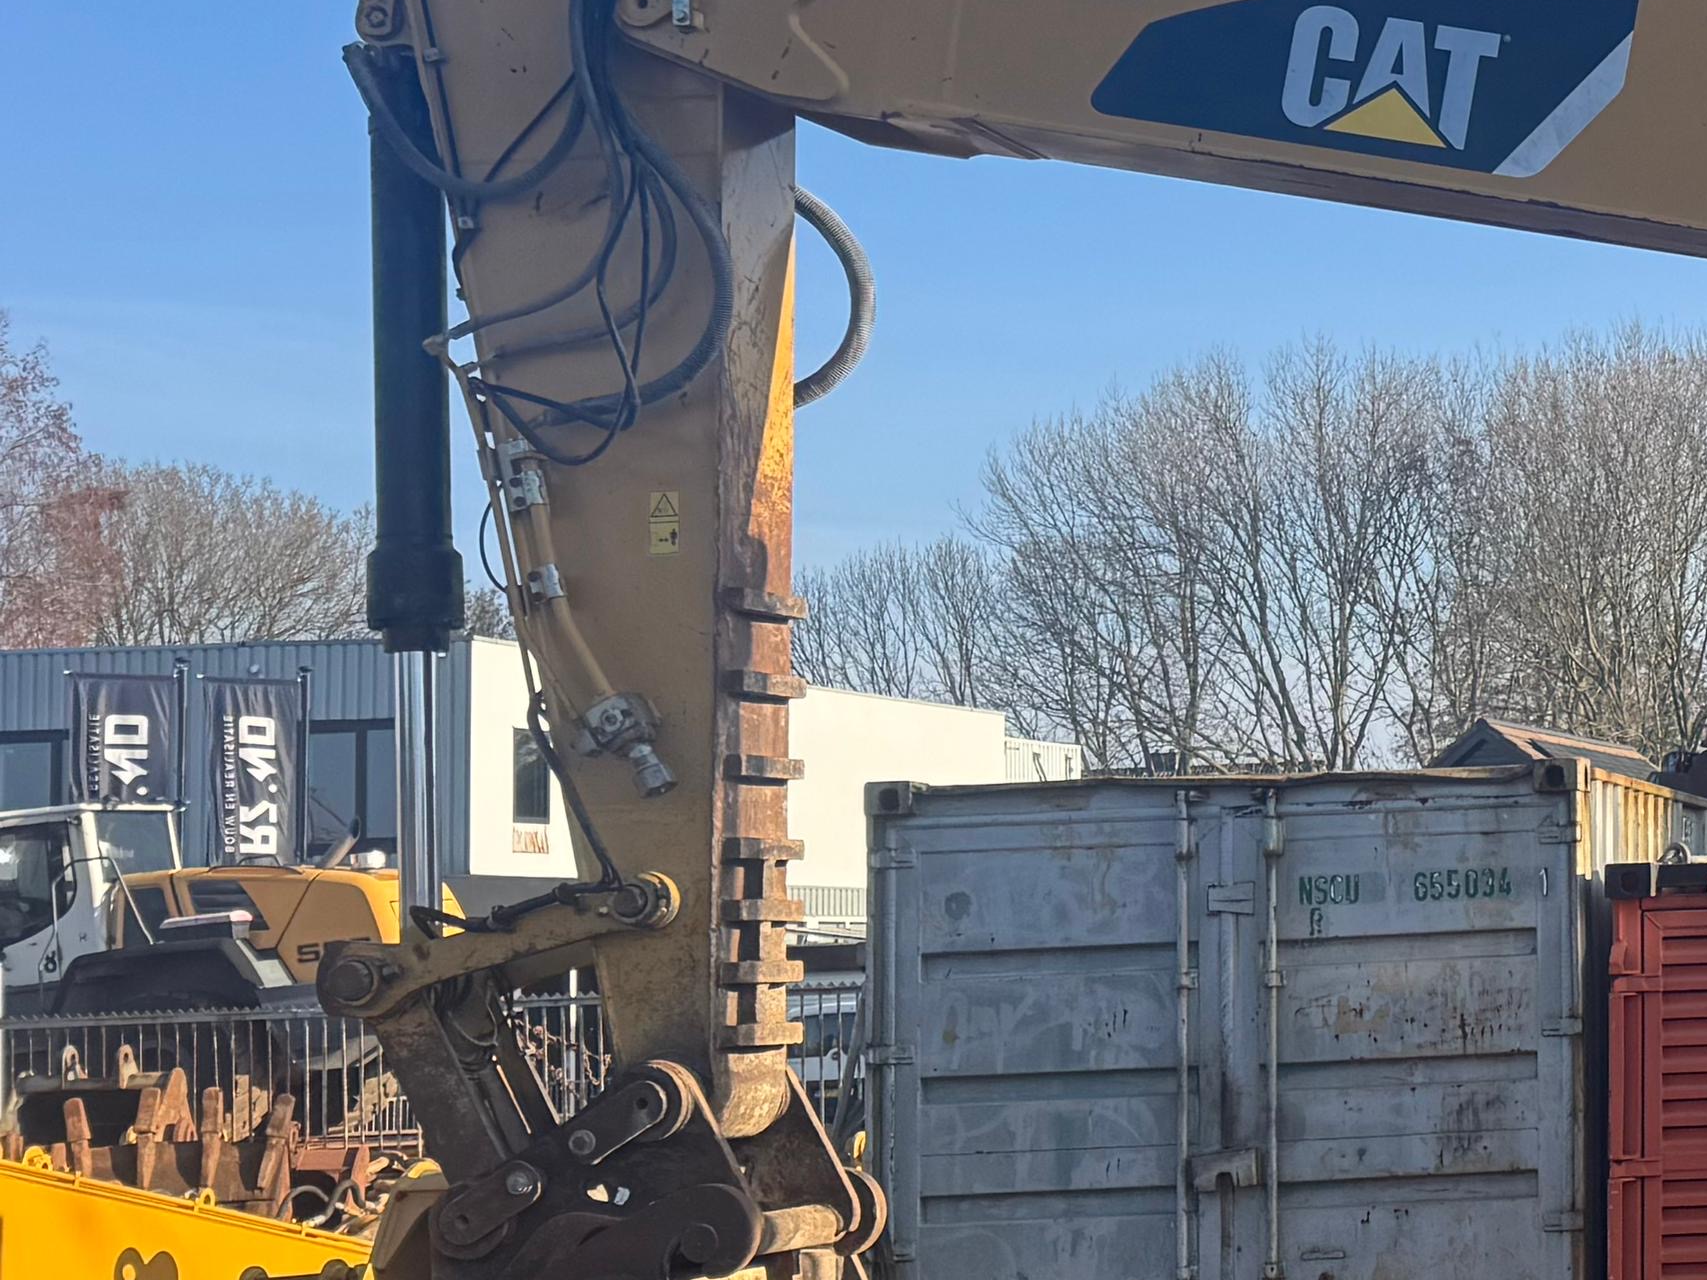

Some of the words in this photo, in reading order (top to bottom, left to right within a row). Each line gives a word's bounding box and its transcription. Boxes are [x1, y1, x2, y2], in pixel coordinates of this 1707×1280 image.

[1281, 5, 1501, 150] CAT
[1299, 874, 1360, 905] NSCU
[1413, 868, 1512, 902] 655034
[1538, 868, 1549, 897] 1
